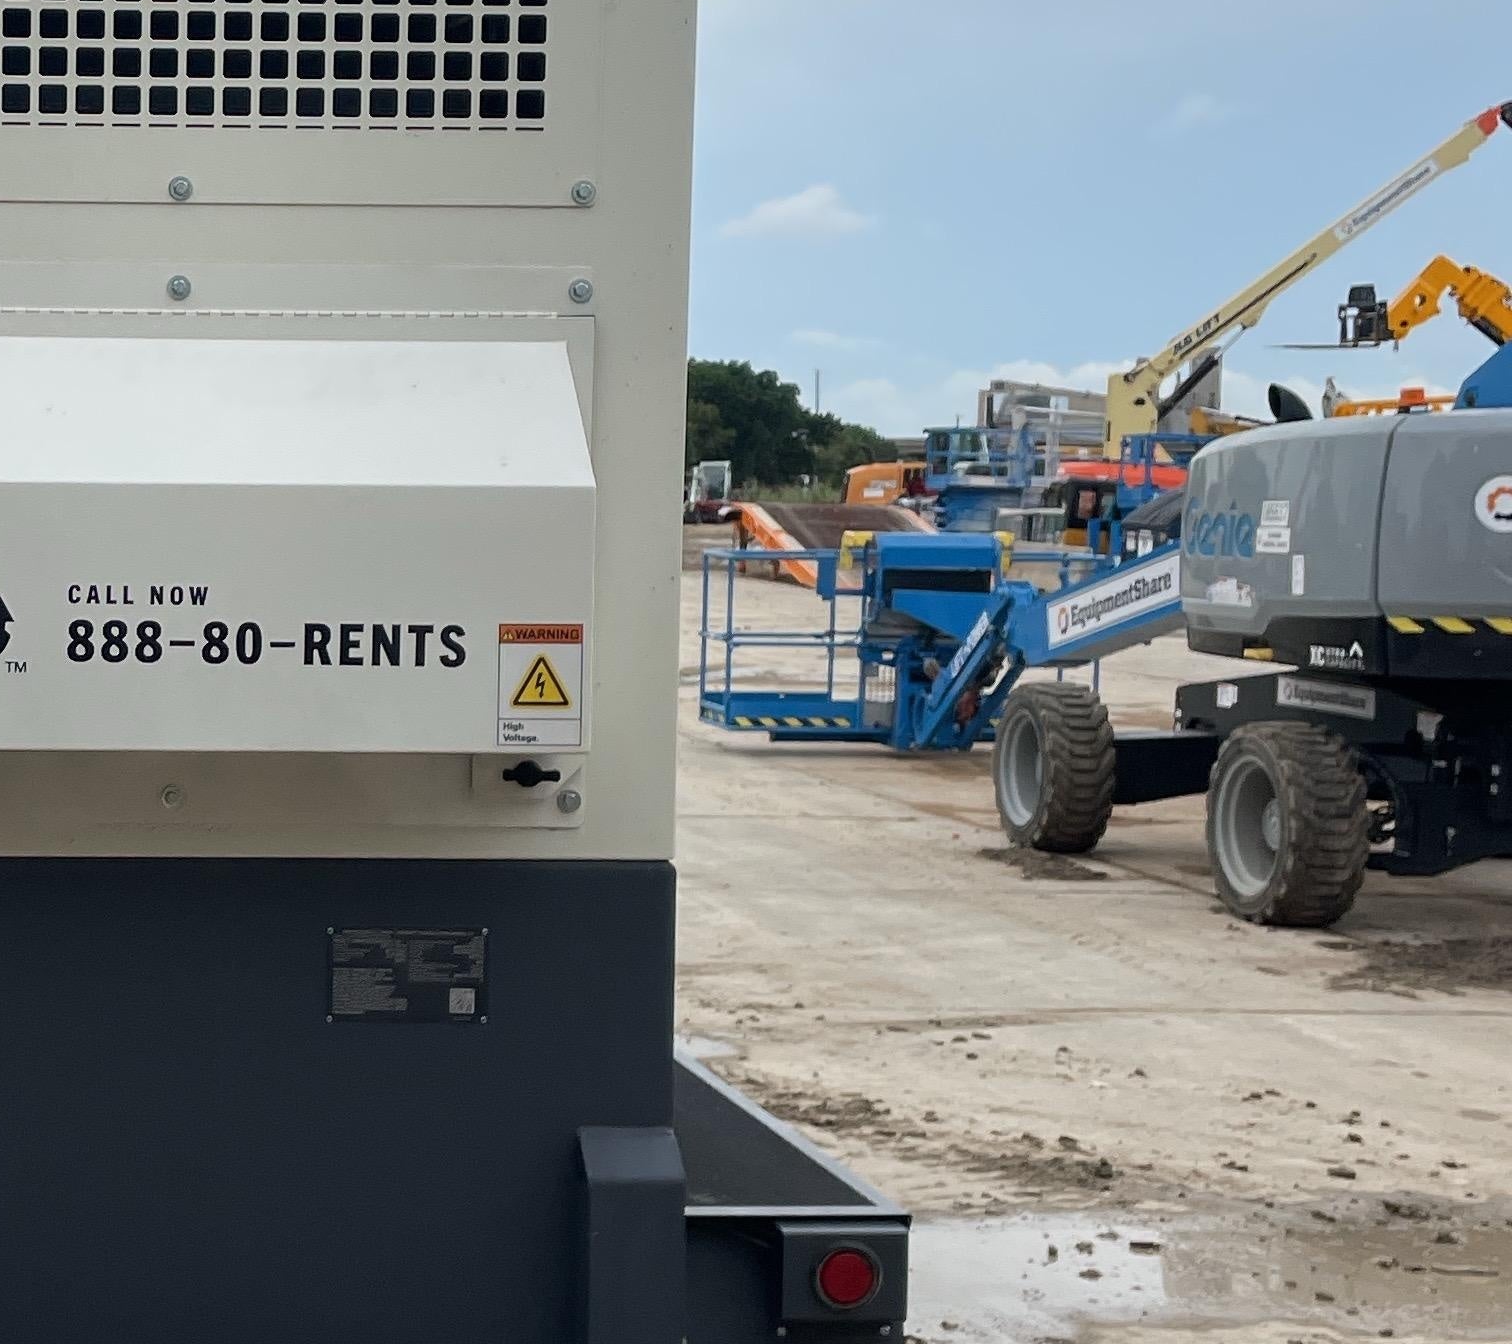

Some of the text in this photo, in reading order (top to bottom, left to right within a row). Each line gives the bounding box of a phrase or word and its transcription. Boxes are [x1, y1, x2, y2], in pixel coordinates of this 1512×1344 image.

[68, 584, 209, 606] CALL NOW
[1071, 572, 1172, 629] EquipmentShare
[515, 628, 580, 640] WARNING
[67, 619, 466, 668] 888-80-RENTS
[5, 661, 27, 674] TM
[503, 722, 524, 731] High
